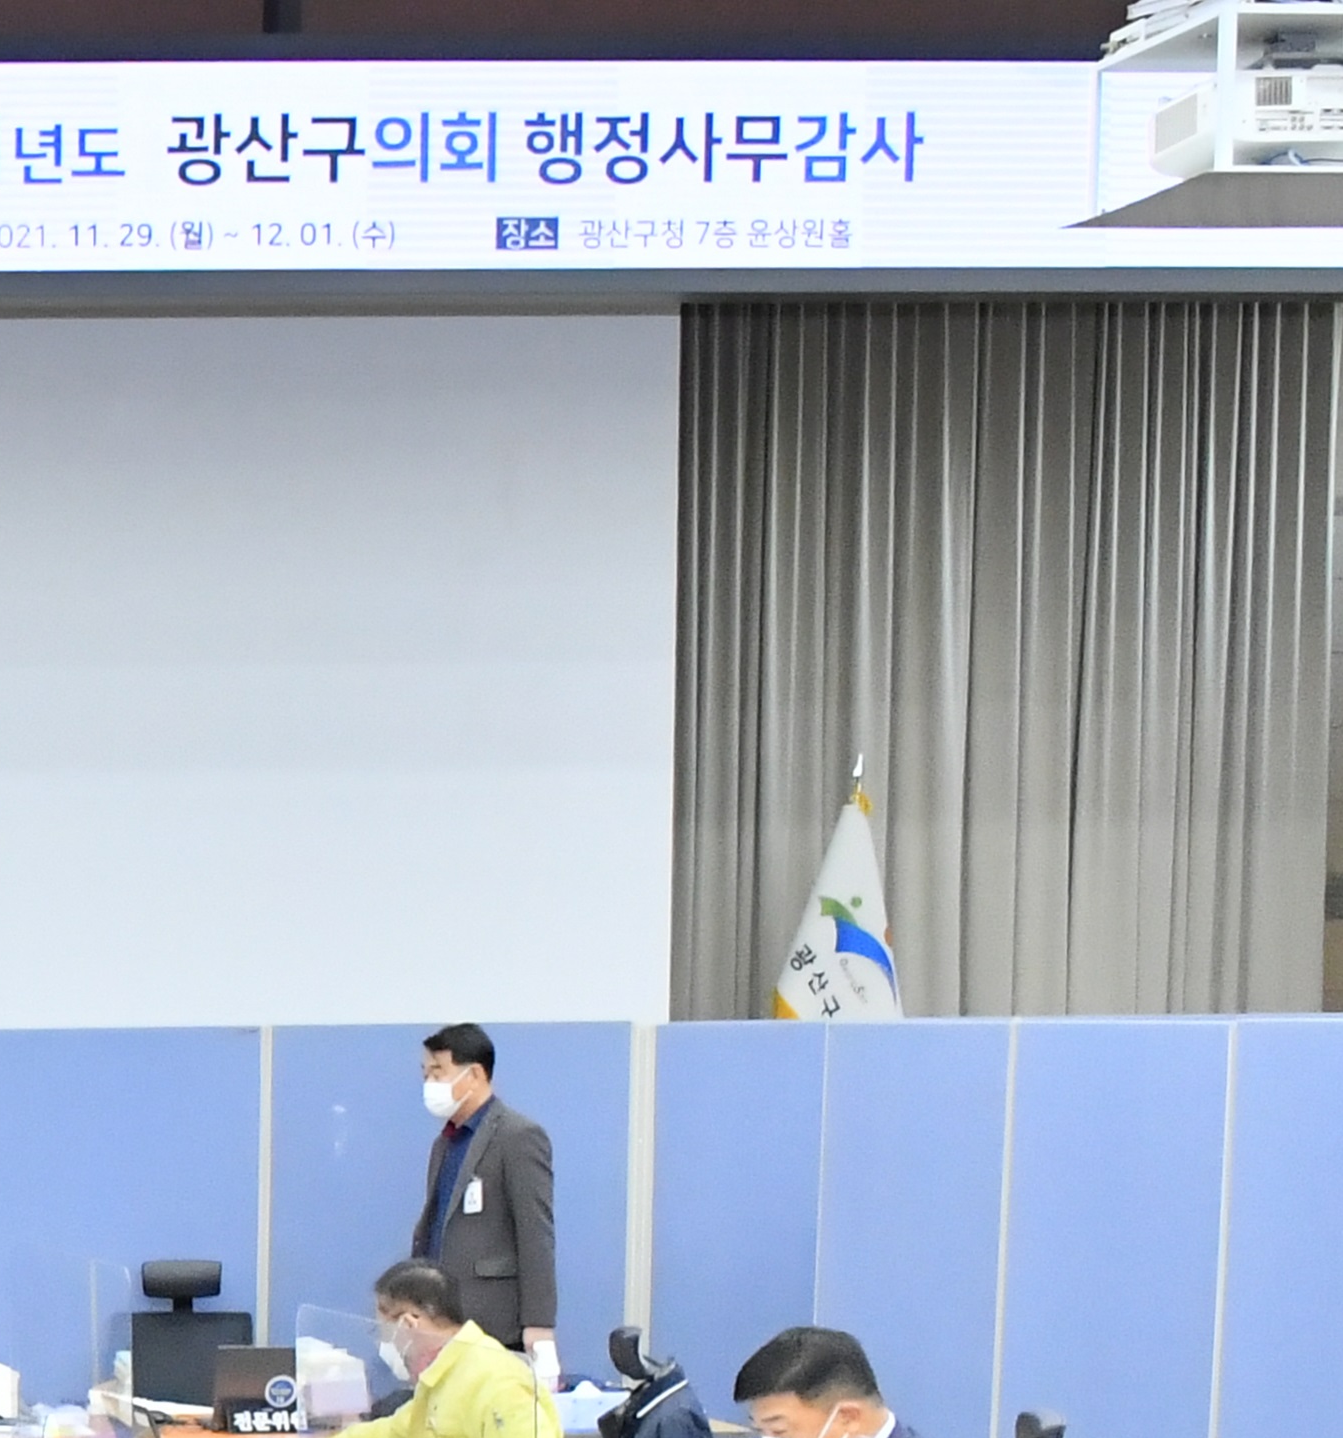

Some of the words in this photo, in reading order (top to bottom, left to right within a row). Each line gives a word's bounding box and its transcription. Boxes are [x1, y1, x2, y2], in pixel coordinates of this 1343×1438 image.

[167, 112, 497, 185] 광산구의회
[524, 111, 924, 185] 행정사무감사
[69, 223, 109, 248] 11.
[119, 223, 160, 248] 29.
[170, 220, 213, 250] (월)
[251, 222, 290, 247] 12.
[300, 222, 342, 247] 01.
[352, 220, 395, 250] (수)
[501, 218, 556, 250] 장소
[578, 219, 684, 249] 광산구청
[695, 219, 738, 249] 7층
[746, 218, 853, 249] 윤상원홀
[790, 944, 840, 1017] 광산구
